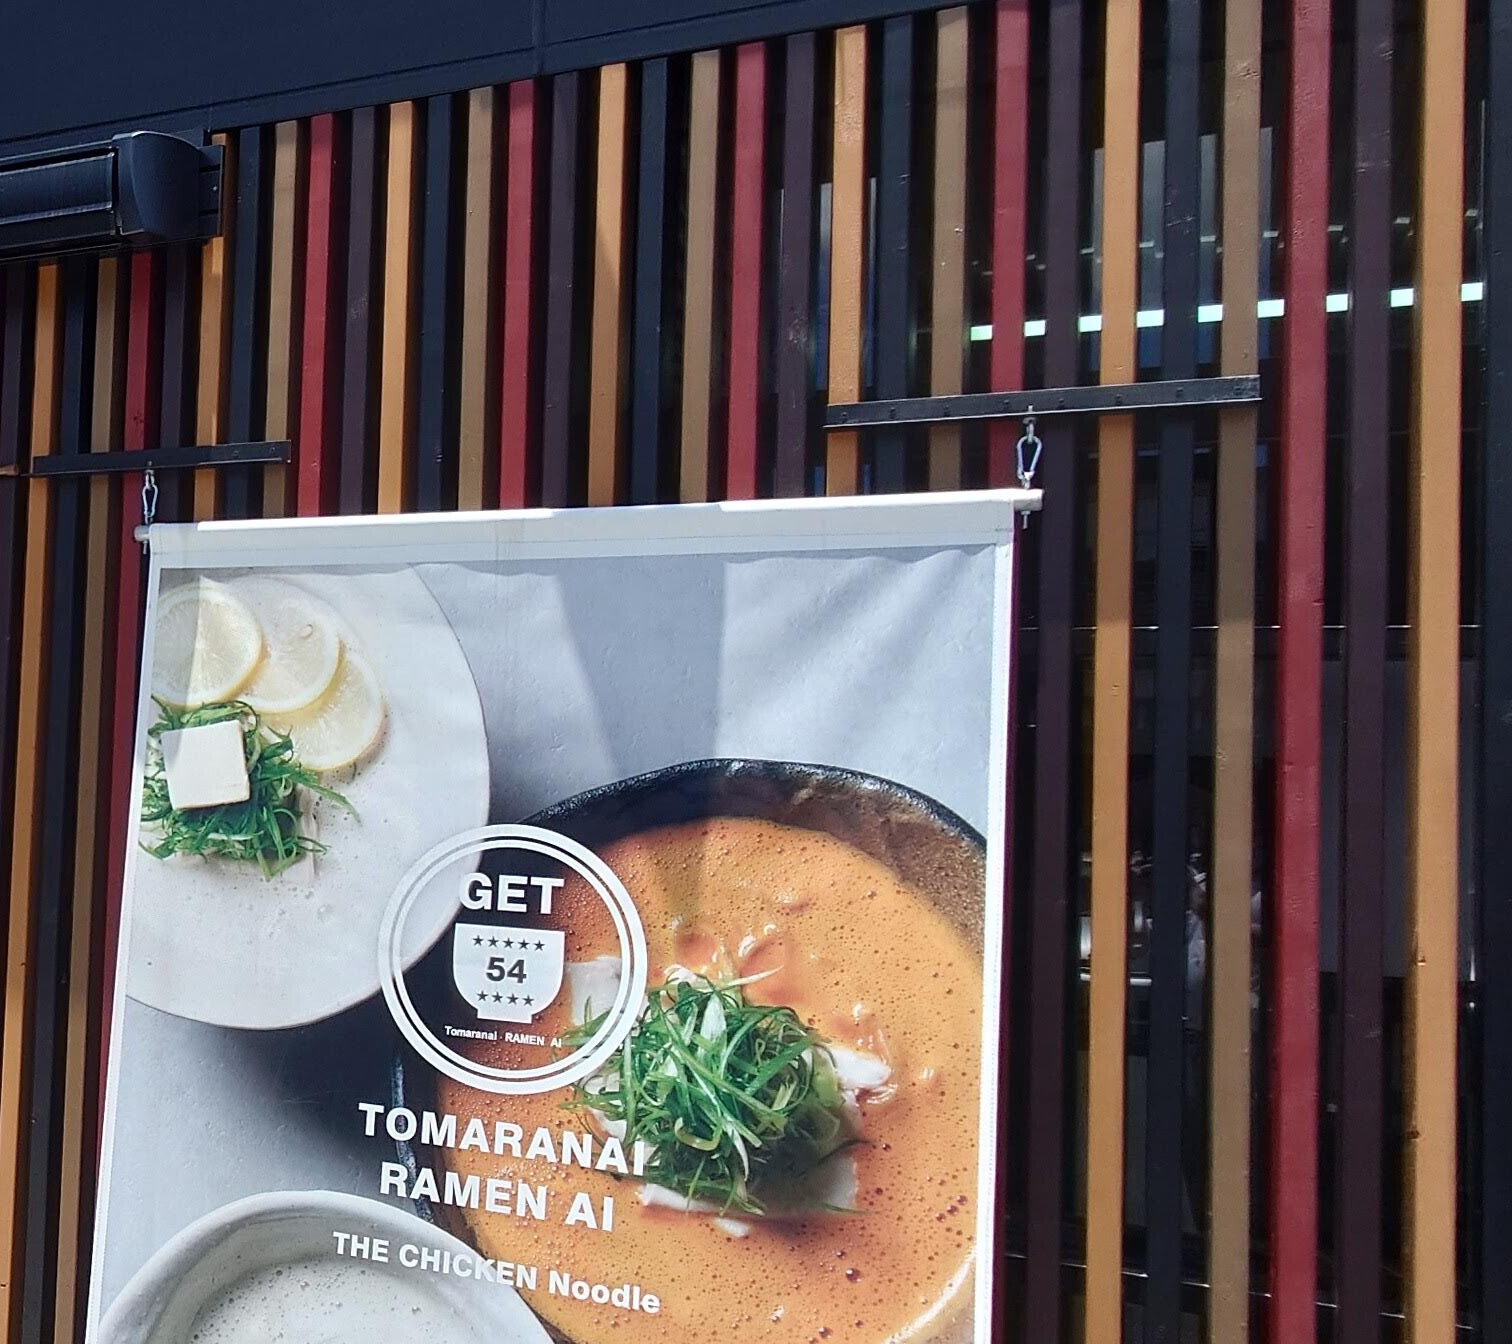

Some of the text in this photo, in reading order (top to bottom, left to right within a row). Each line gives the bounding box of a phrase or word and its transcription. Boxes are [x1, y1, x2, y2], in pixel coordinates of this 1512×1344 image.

[459, 872, 565, 915] GET
[486, 957, 527, 984] 54
[445, 1026, 497, 1041] Tomaranai
[505, 1032, 545, 1046] RAMEN
[358, 1103, 648, 1176] TOMARANAI
[379, 1161, 614, 1232] RAMEN AI
[333, 1232, 661, 1315] THE CHICKEN Noodle
